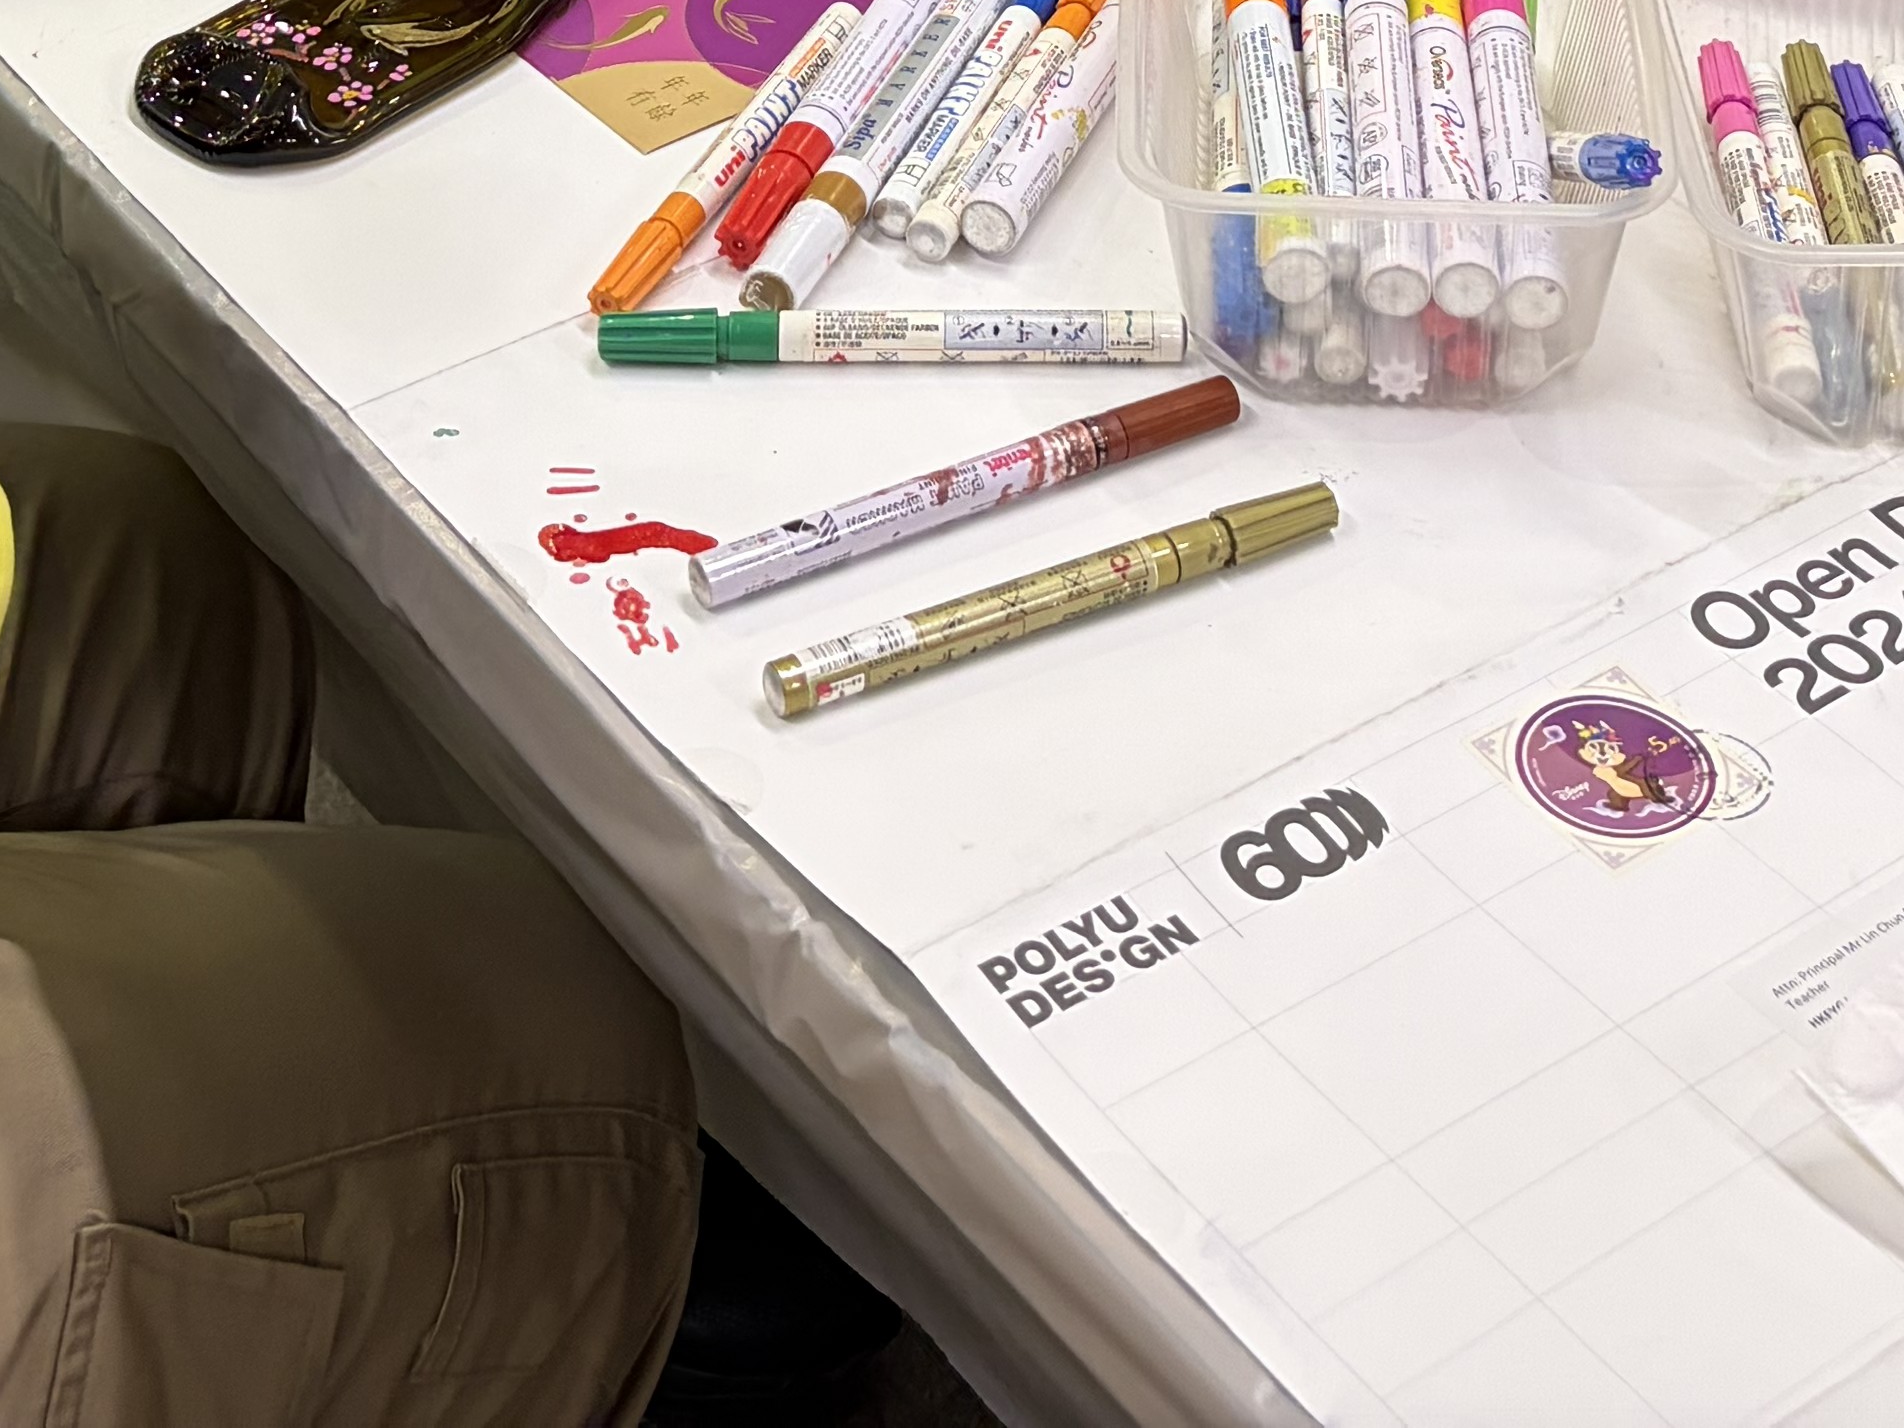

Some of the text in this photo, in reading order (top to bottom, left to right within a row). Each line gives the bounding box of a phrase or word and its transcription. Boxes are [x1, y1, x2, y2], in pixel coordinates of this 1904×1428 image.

[983, 15, 1018, 54] uni
[709, 44, 835, 190] uni PAINT MARKER
[840, 111, 884, 158] Sipa
[870, 10, 957, 112] MARKER
[935, 42, 1005, 122] PAINT
[1689, 526, 1901, 652] Open
[976, 894, 1140, 995] POLYU
[1797, 946, 1847, 985] Principal
[1841, 936, 1863, 956] Mr
[1858, 925, 1880, 945] Lin
[1784, 977, 1831, 1012] Teacher
